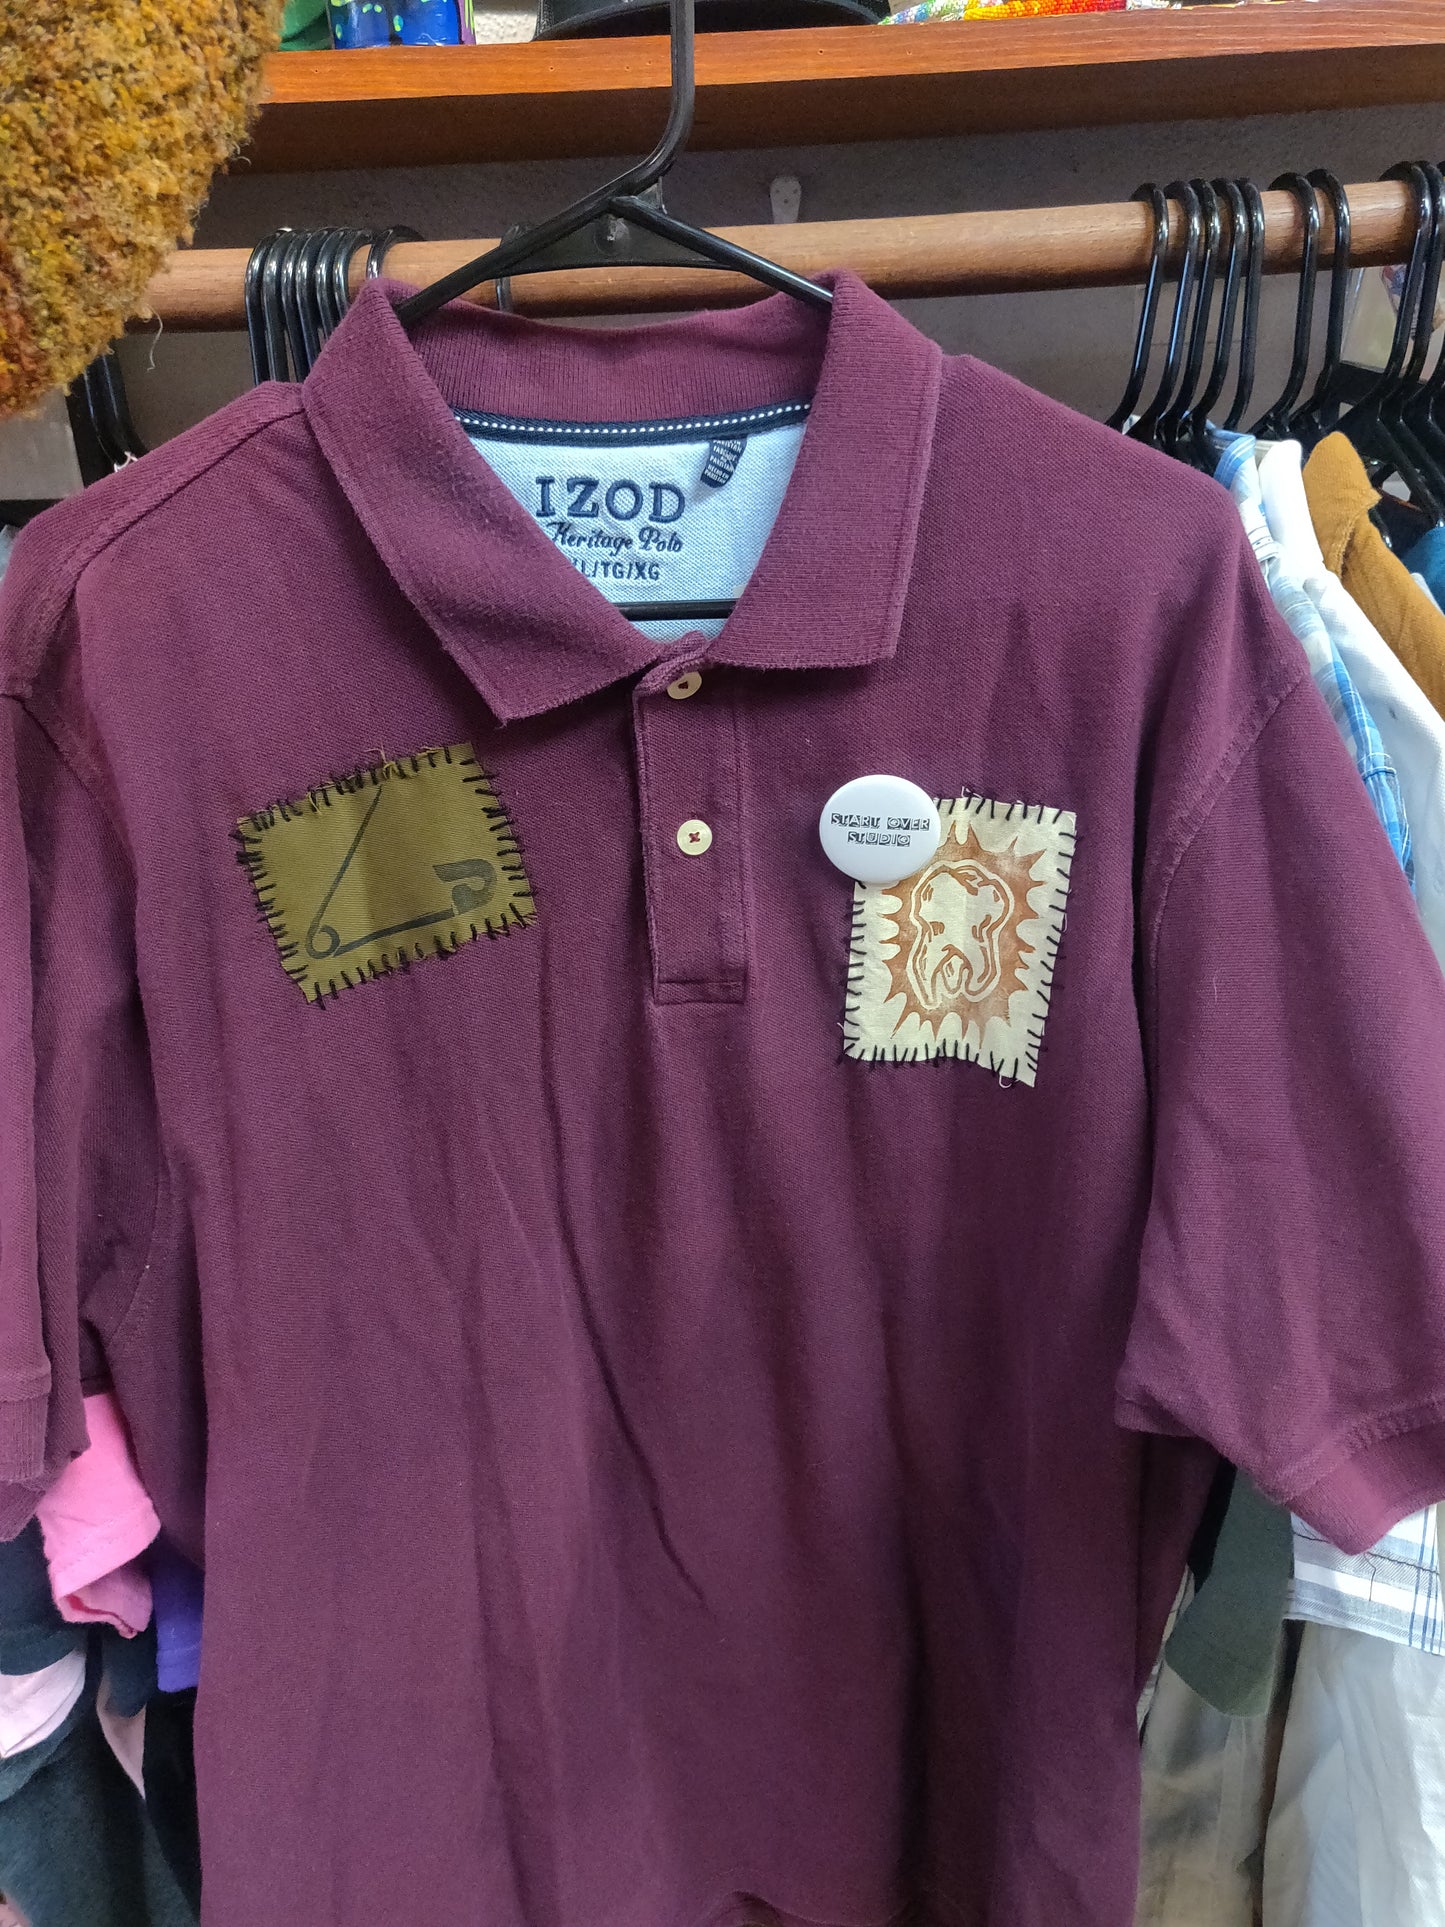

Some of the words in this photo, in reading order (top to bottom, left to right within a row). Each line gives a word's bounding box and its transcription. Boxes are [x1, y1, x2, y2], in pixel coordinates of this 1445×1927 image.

[535, 476, 686, 523] IZOD
[546, 521, 634, 557] Heritage
[638, 525, 683, 553] Polo
[831, 812, 881, 829] START
[886, 816, 931, 831] OVER
[847, 831, 911, 847] STUDIO
